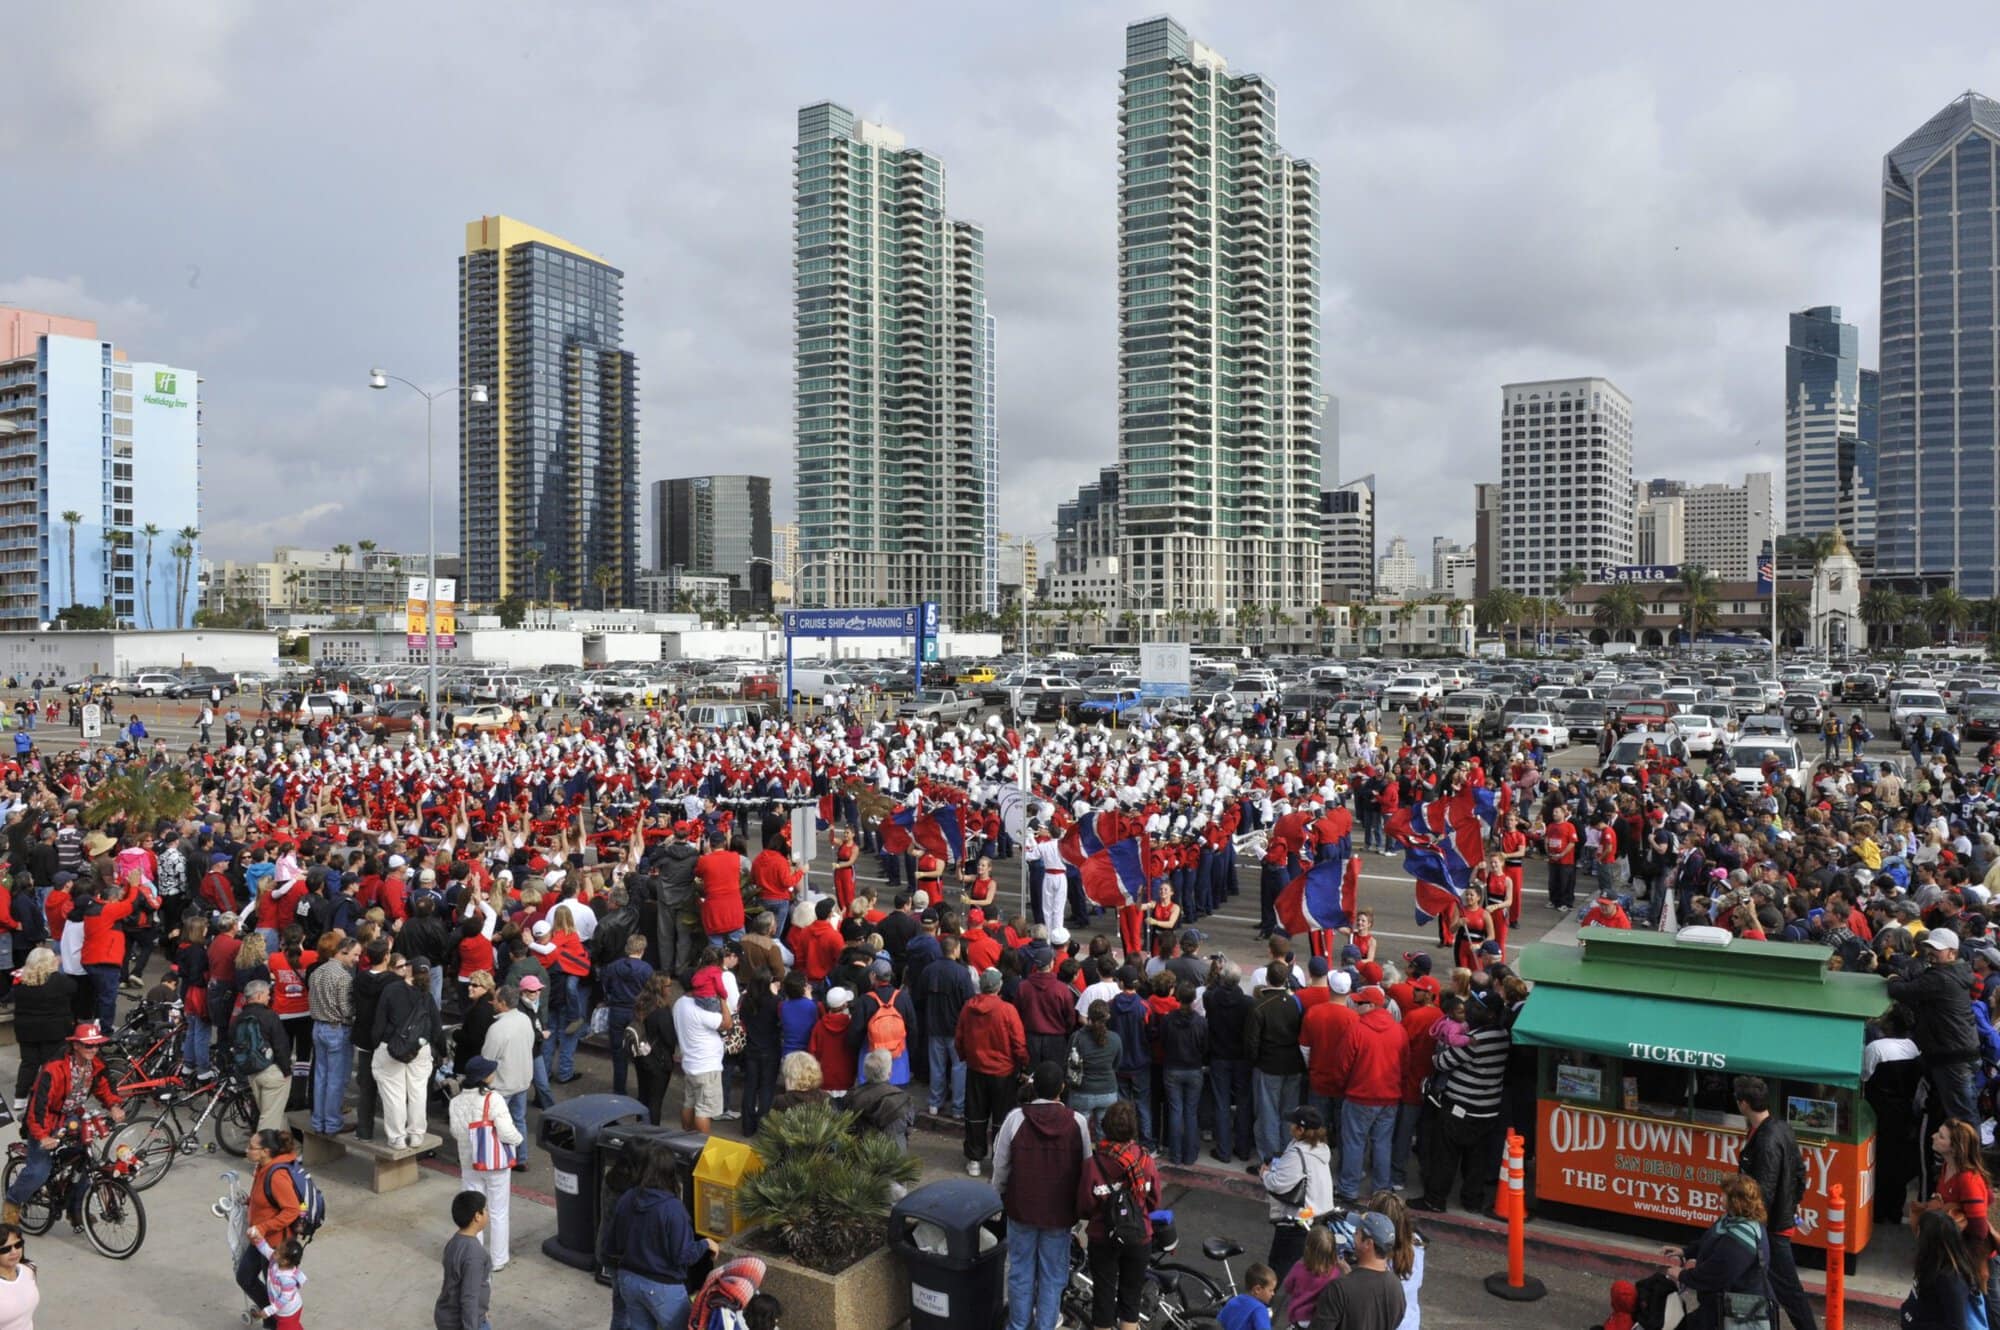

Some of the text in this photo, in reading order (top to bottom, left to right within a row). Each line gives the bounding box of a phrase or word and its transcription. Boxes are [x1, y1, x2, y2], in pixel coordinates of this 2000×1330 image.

[144, 394, 187, 408] Holiday Inn
[1604, 567, 1665, 580] Santa
[799, 618, 827, 629] CRUISE
[828, 617, 846, 629] SHIP
[867, 617, 902, 629] PARKING
[926, 603, 936, 626] 5
[927, 642, 935, 659] P
[1628, 1042, 1726, 1069] TICKETS
[1550, 1107, 1607, 1153] OLD
[1612, 1117, 1693, 1157] TOWN
[1615, 1153, 1640, 1172] SAN
[1643, 1159, 1681, 1178] DIEGO
[1684, 1166, 1694, 1181] &
[1562, 1168, 1607, 1192] THE
[1612, 1176, 1680, 1205] CITY'S
